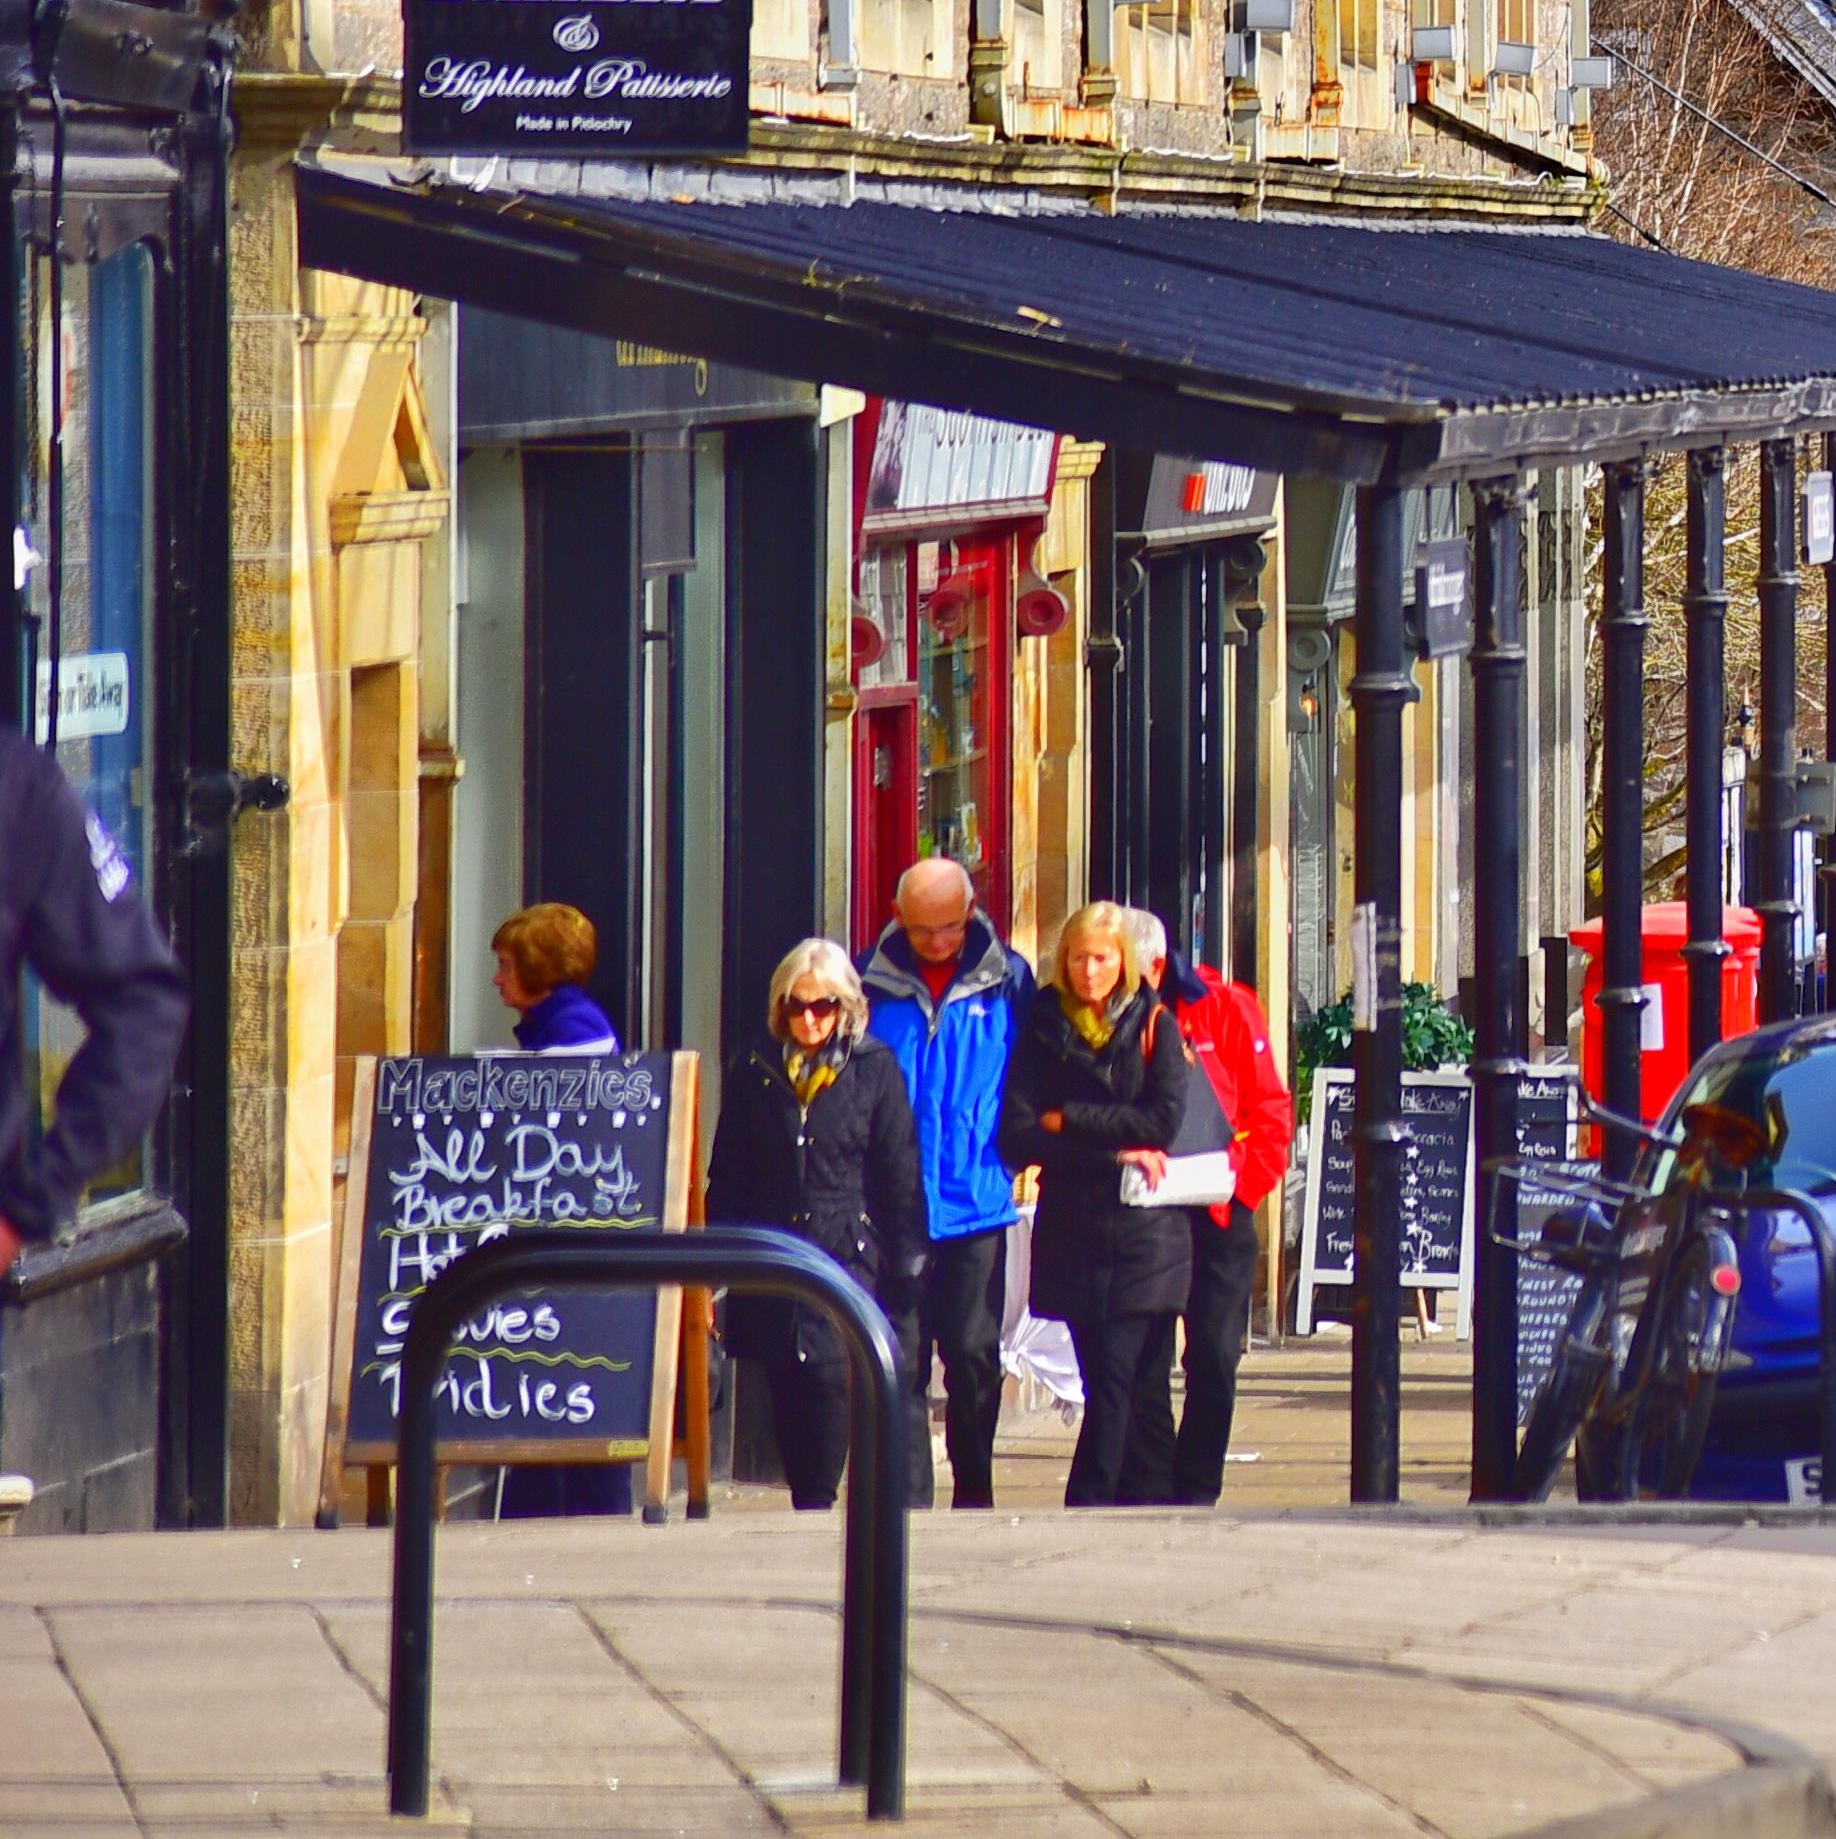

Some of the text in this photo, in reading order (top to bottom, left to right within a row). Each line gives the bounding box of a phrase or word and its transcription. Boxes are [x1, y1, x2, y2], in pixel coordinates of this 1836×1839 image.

[552, 12, 600, 52] &
[418, 56, 732, 113] Highland Patisserie
[516, 115, 554, 132] Made
[556, 115, 569, 132] in
[388, 1123, 633, 1194] All Day
[394, 1175, 643, 1229] Breakfast
